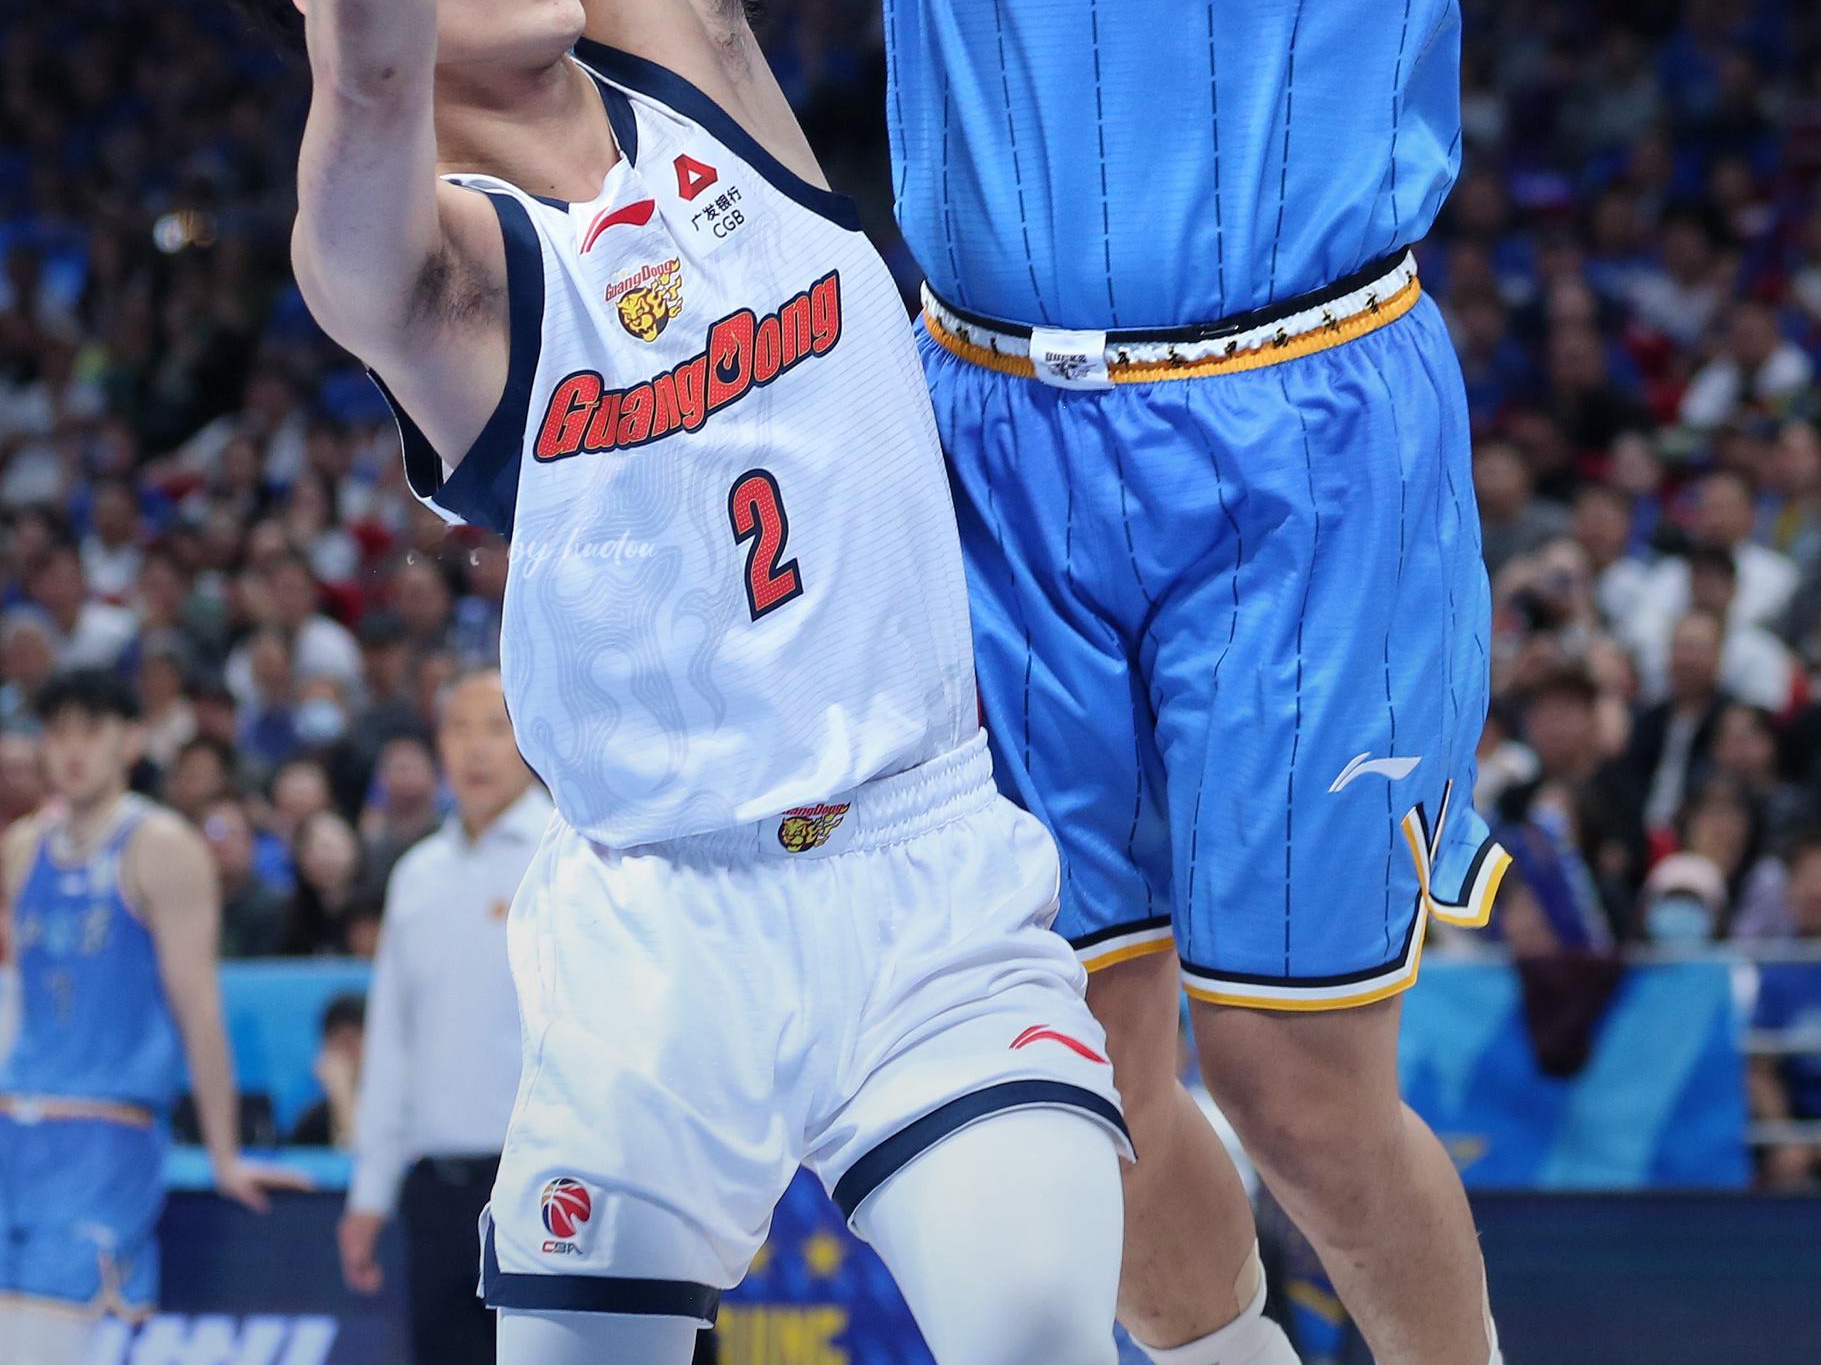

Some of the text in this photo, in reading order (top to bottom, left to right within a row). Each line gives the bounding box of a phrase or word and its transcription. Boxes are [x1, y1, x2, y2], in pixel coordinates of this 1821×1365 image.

[691, 185, 742, 231] 广发银行
[713, 209, 745, 238] CGB
[605, 259, 675, 302] GuangDong
[533, 268, 842, 463] GuangDong
[727, 468, 804, 622] 2
[542, 1240, 583, 1256] CBA
